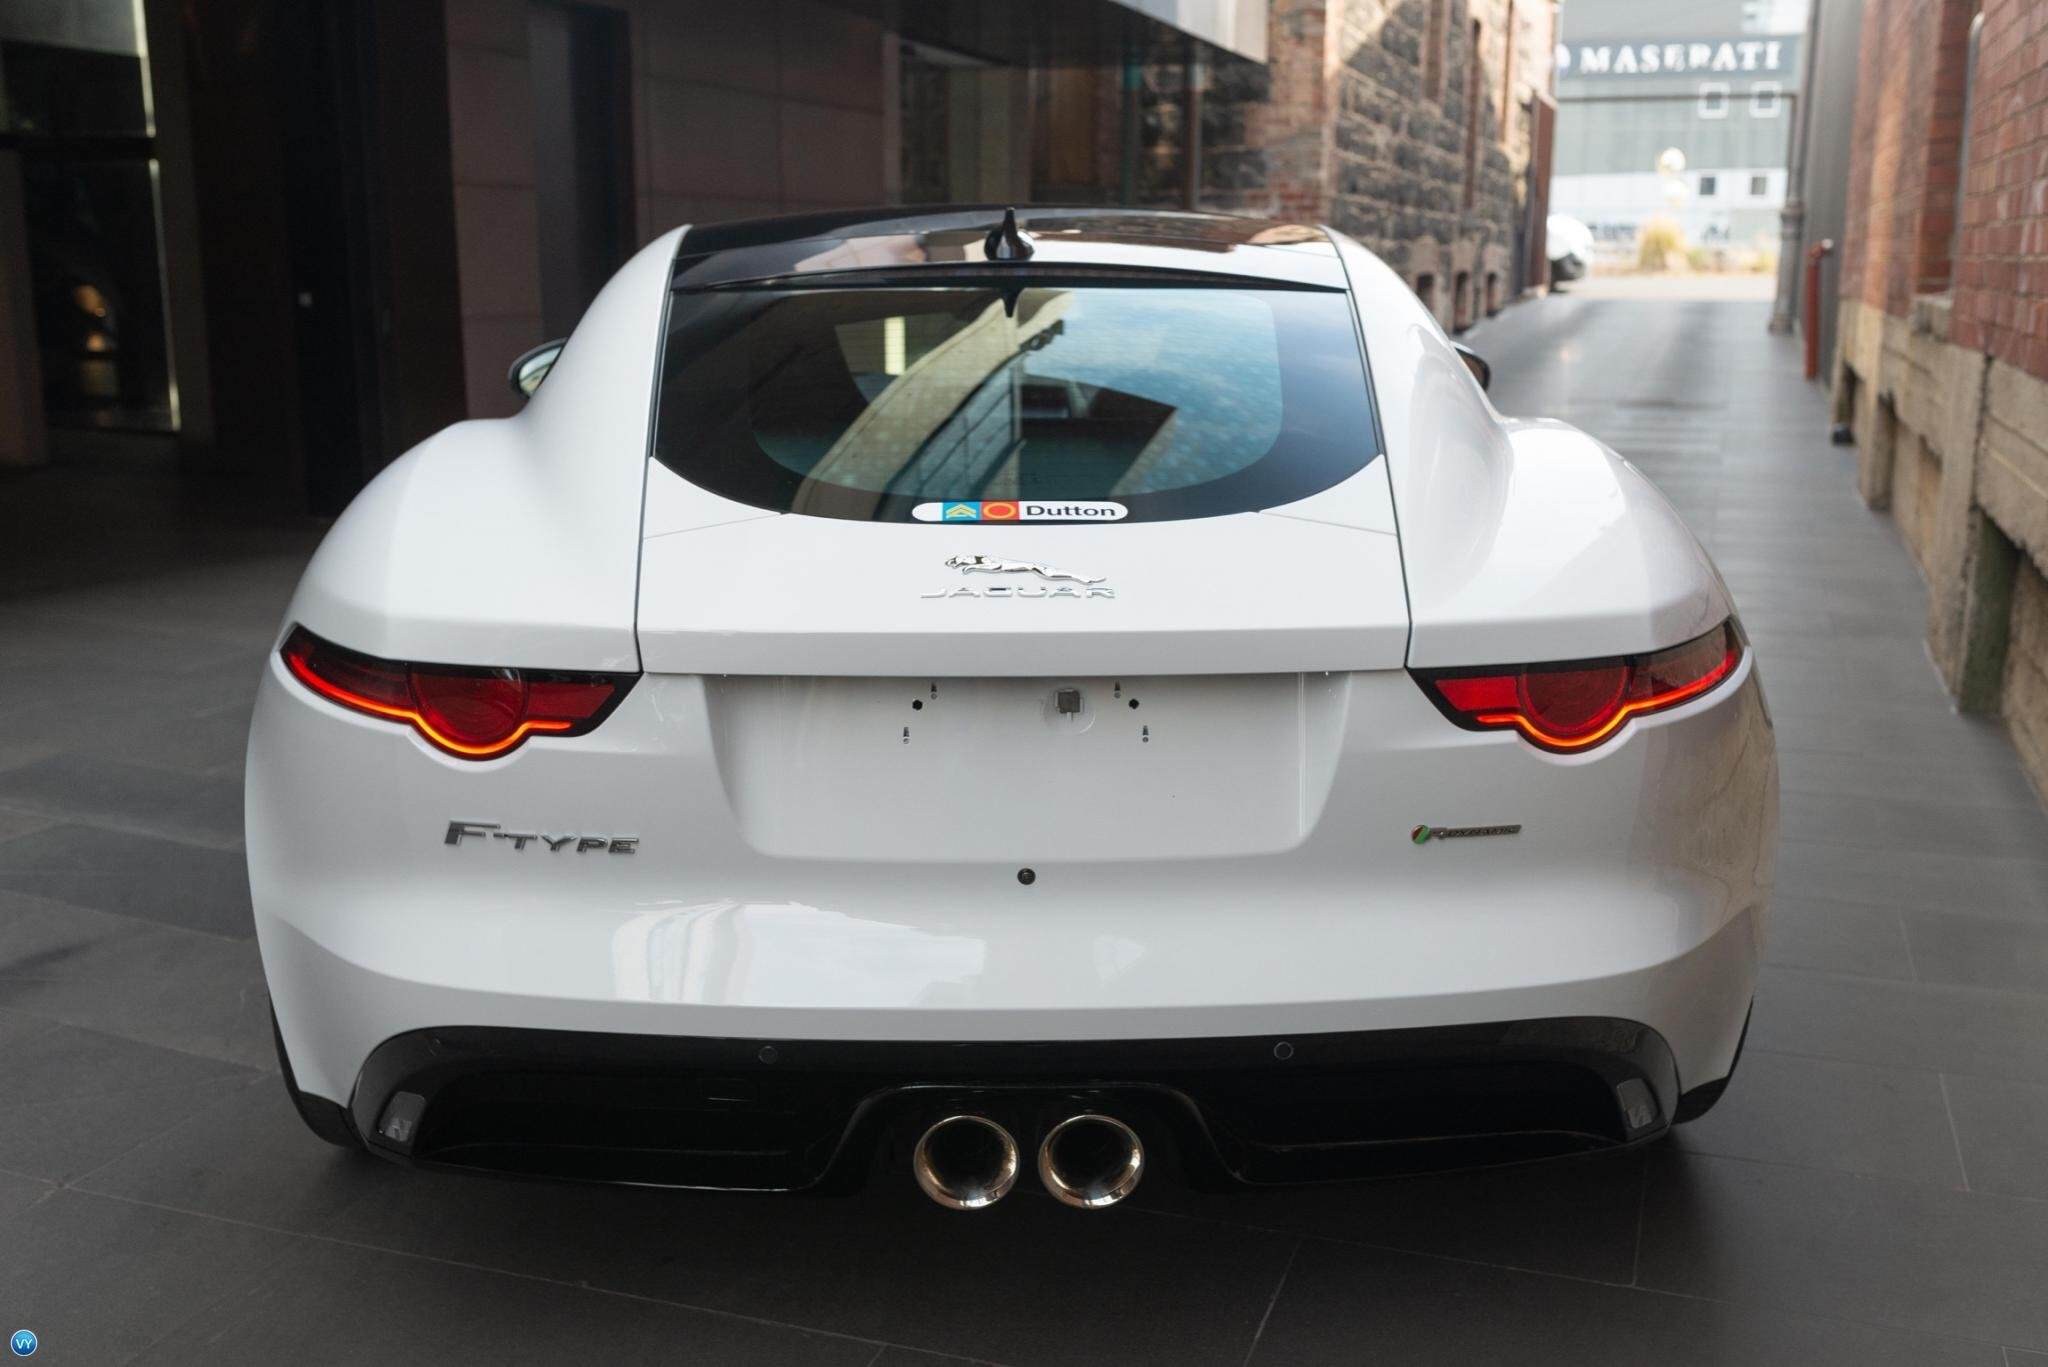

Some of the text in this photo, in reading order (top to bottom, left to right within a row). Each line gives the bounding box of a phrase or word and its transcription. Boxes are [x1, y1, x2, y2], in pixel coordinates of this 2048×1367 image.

[1579, 41, 1782, 74] MASERATI
[1026, 504, 1117, 517] Dutton
[920, 586, 1116, 599] JAGUAR
[444, 820, 640, 856] F-TYPE
